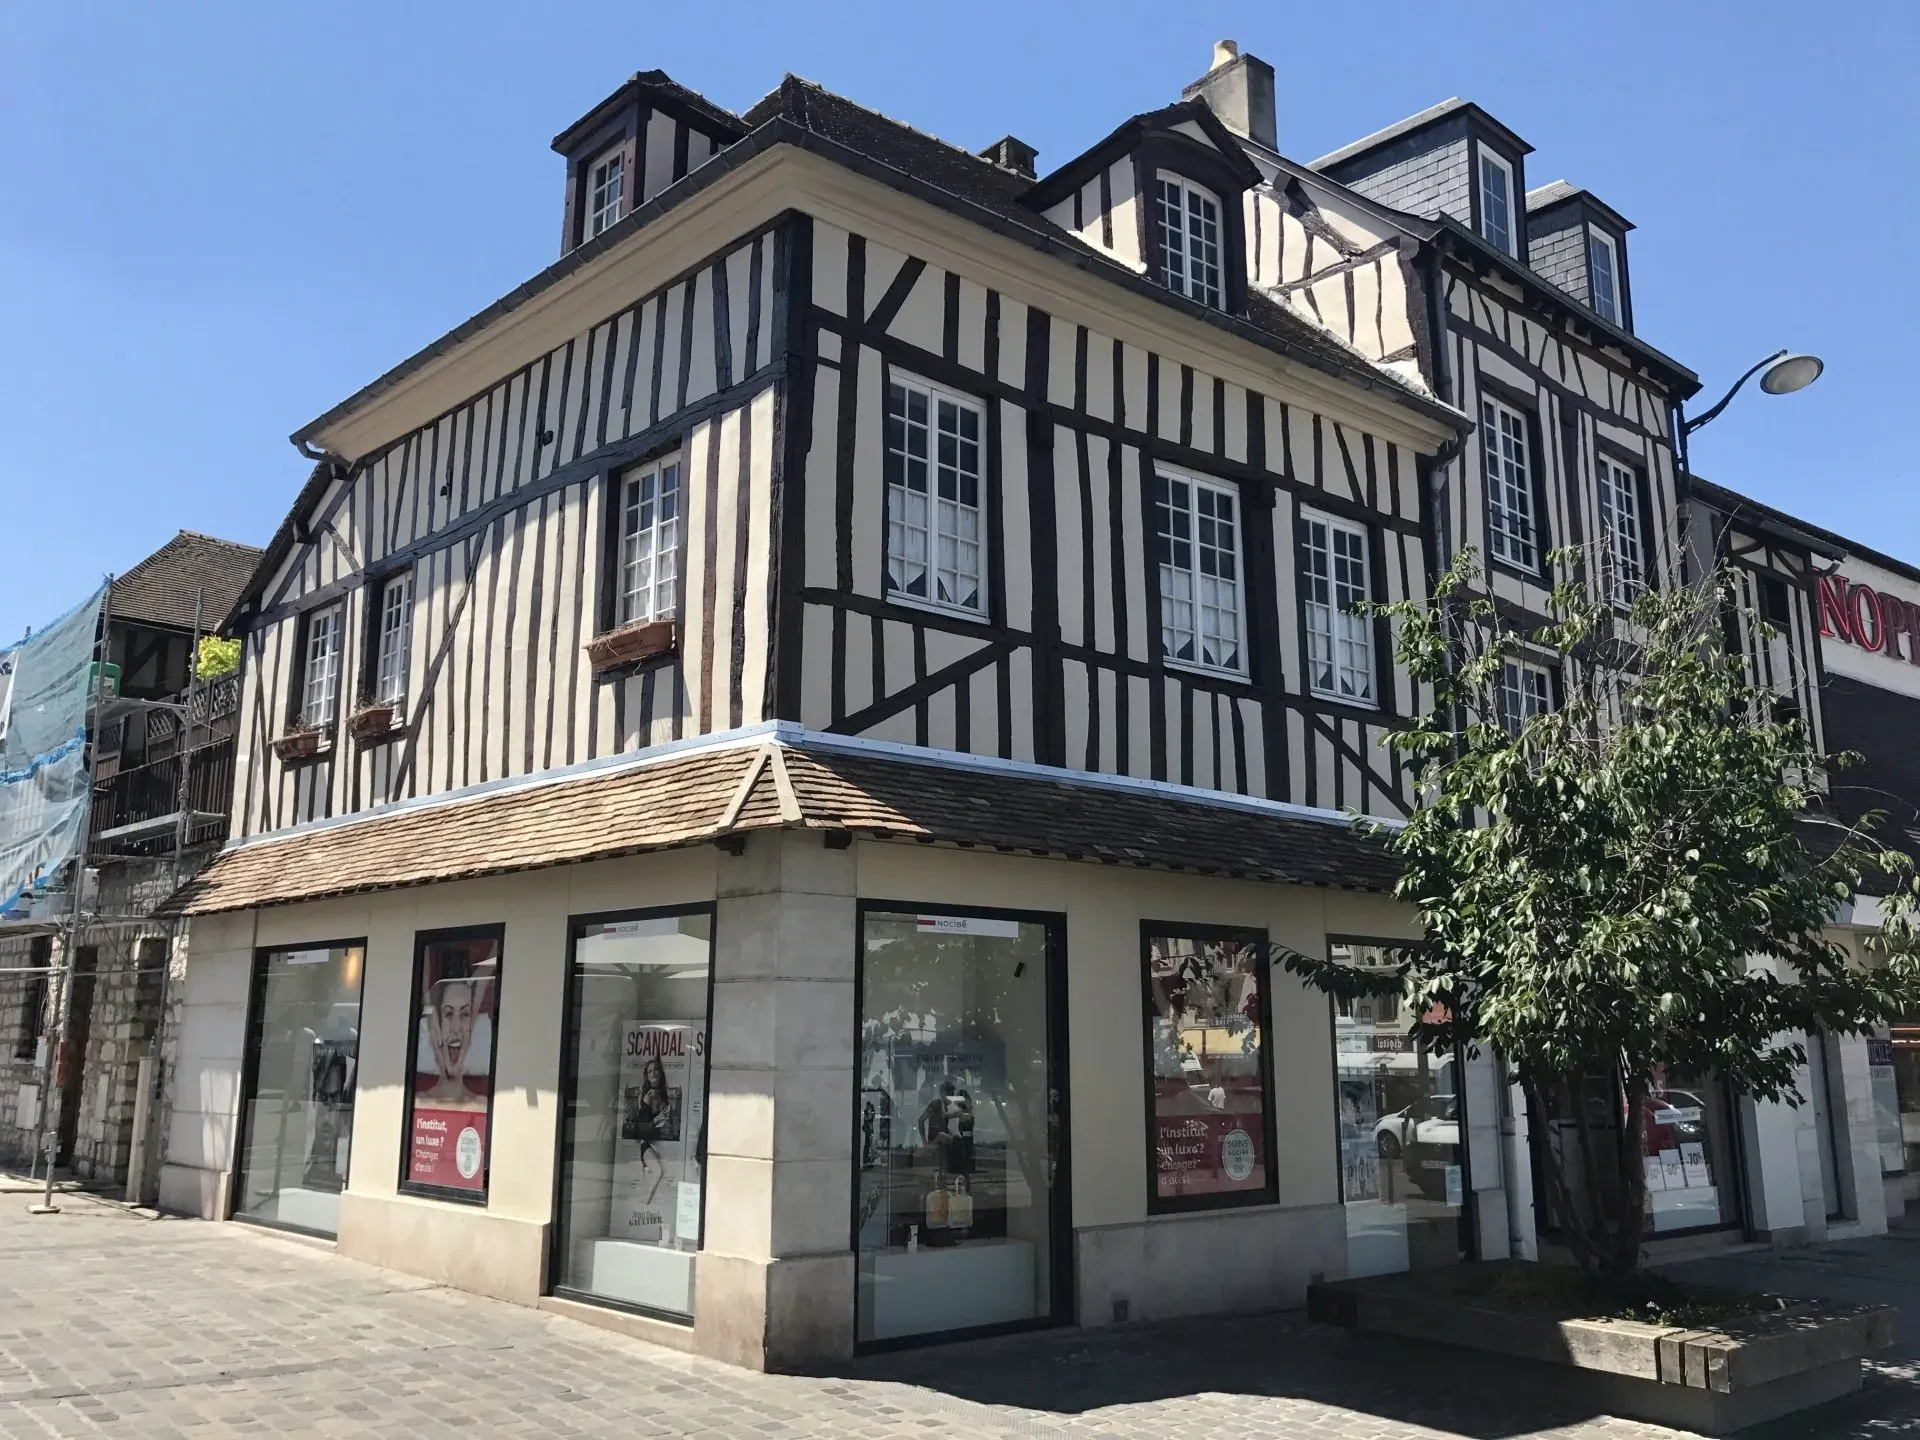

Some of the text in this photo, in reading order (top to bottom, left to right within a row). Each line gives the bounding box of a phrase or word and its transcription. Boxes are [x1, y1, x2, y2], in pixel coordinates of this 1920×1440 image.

[627, 1031, 685, 1056] SCANDAL
[1160, 1126, 1208, 1139] l'institut,
[416, 1136, 426, 1145] un
[1175, 1143, 1198, 1155] luxe
